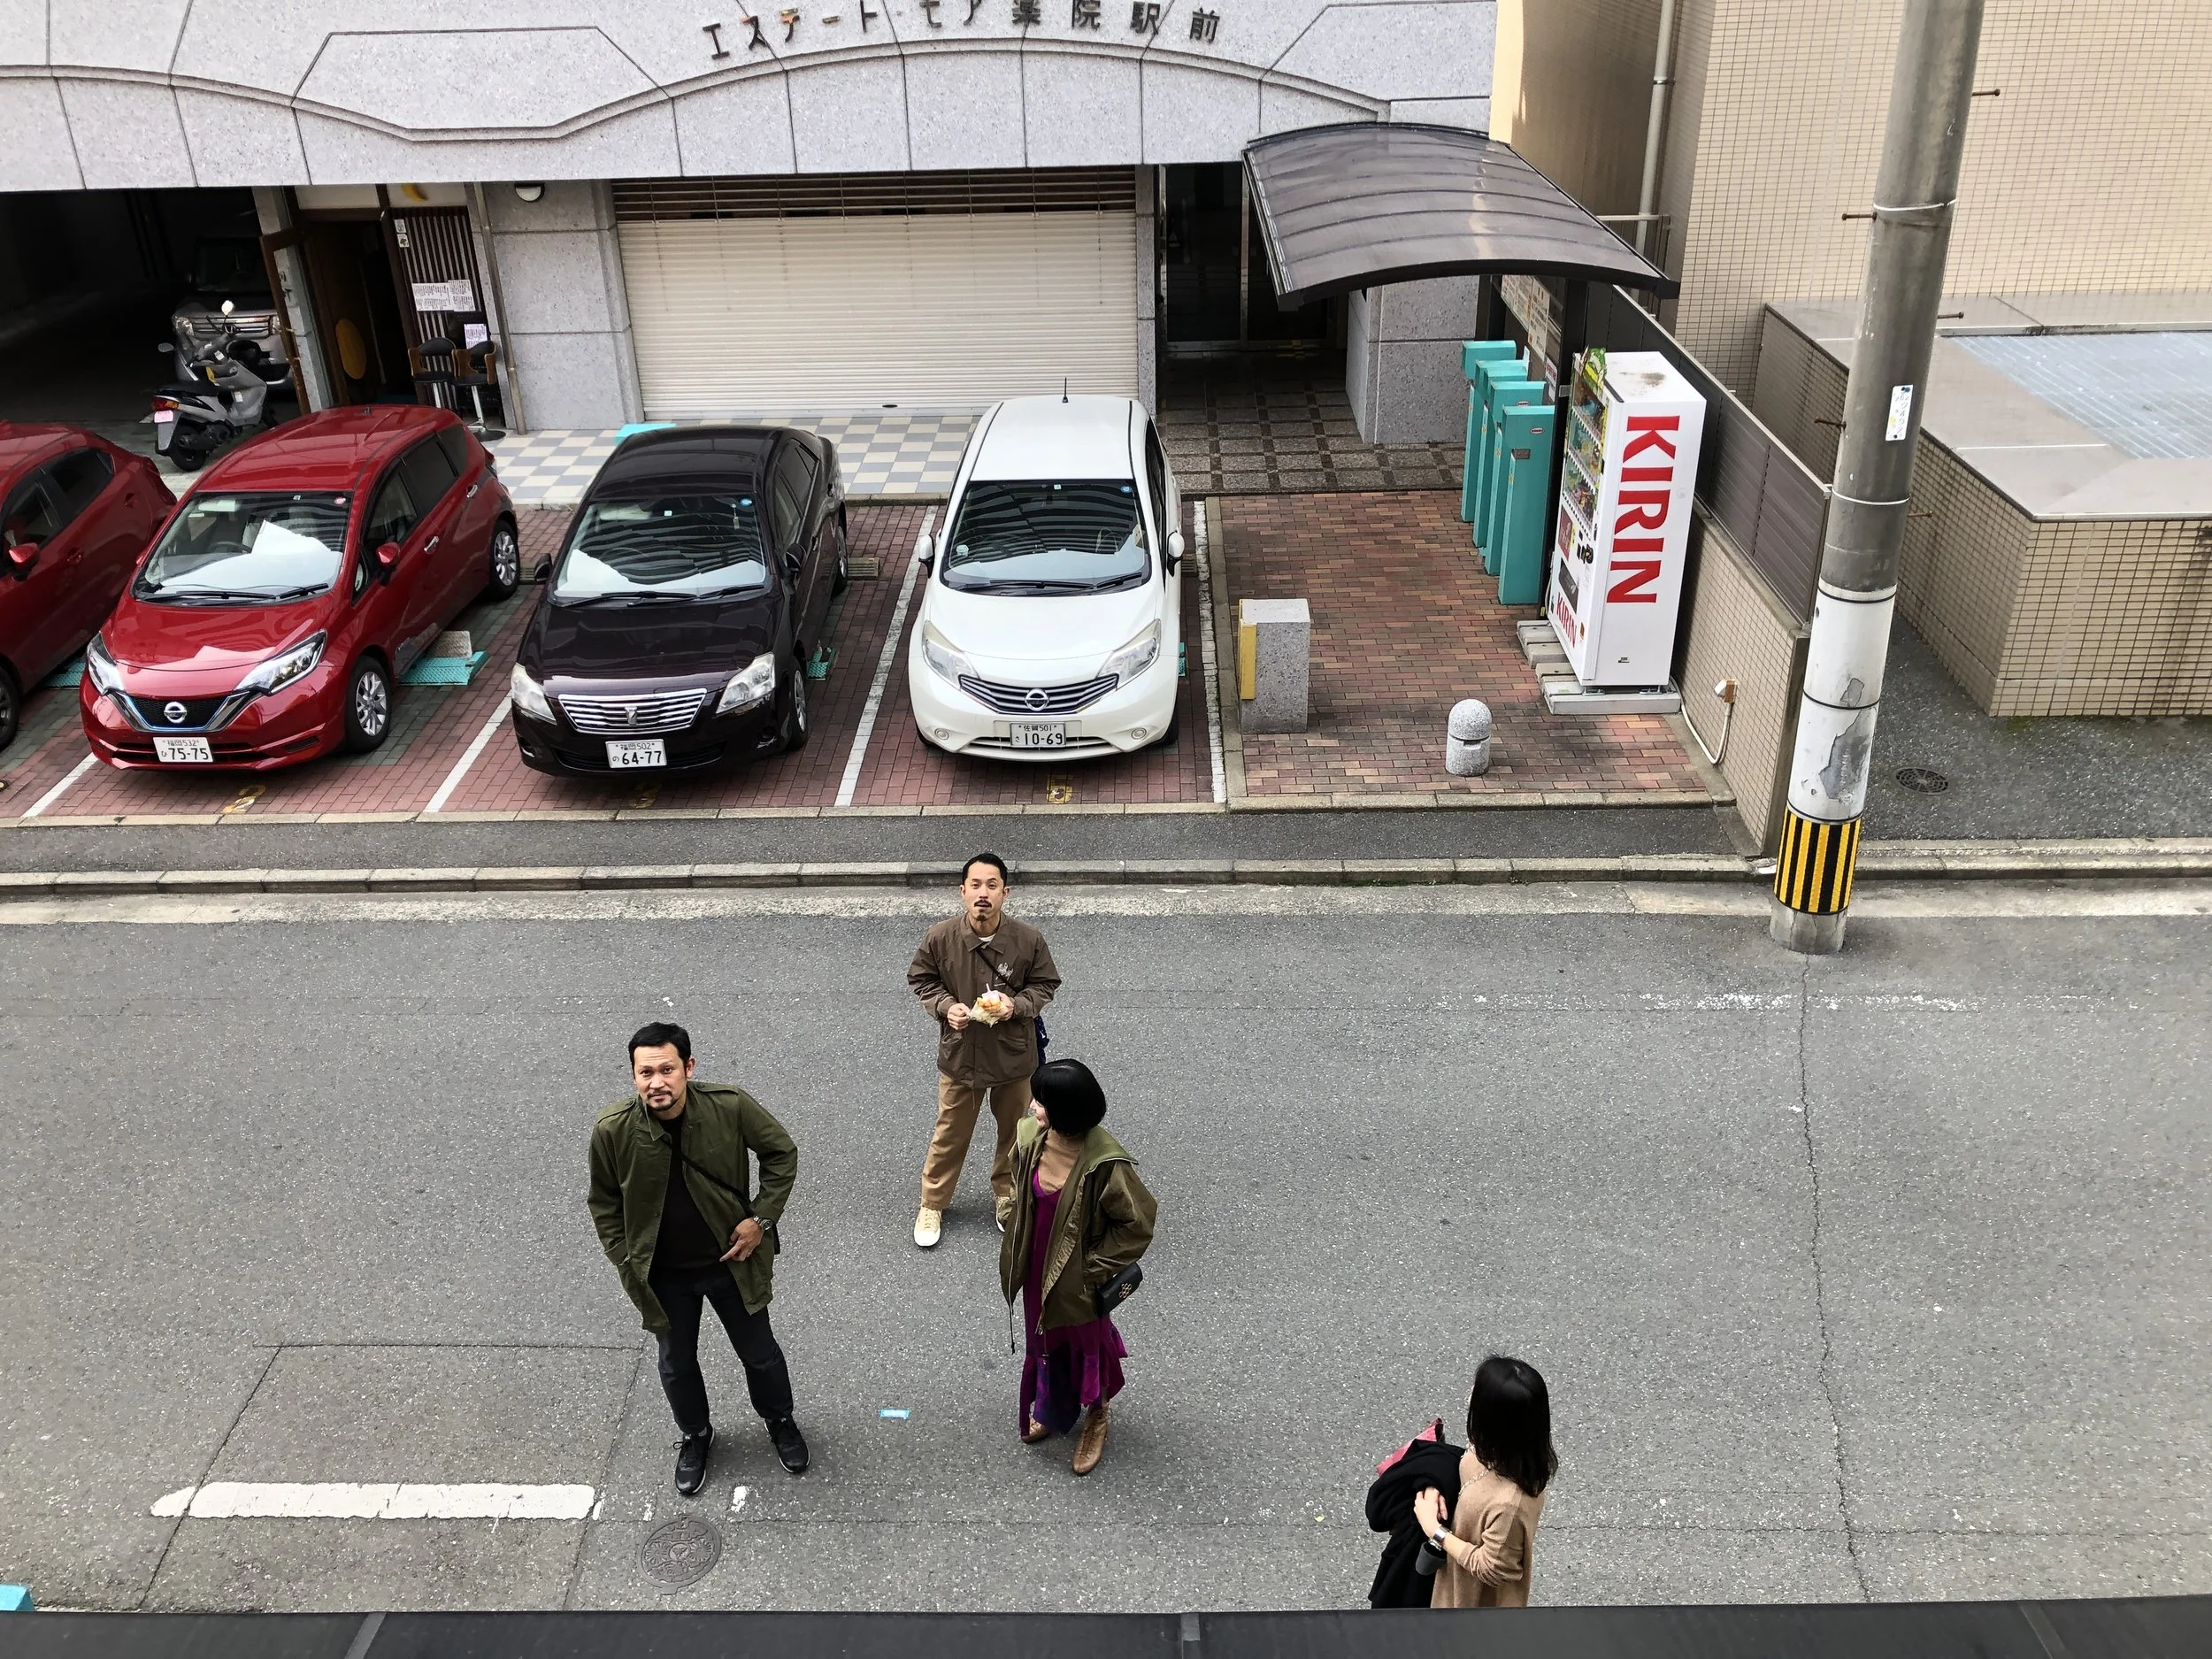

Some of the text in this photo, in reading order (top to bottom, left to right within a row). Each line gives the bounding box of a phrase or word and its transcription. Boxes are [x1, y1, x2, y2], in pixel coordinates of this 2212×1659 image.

[1606, 415, 1681, 603] KIRIN
[1556, 592, 1578, 649] KIRIN
[1025, 733, 1063, 745] 10-69
[168, 748, 210, 761] 75-75
[622, 750, 662, 764] 64-77
